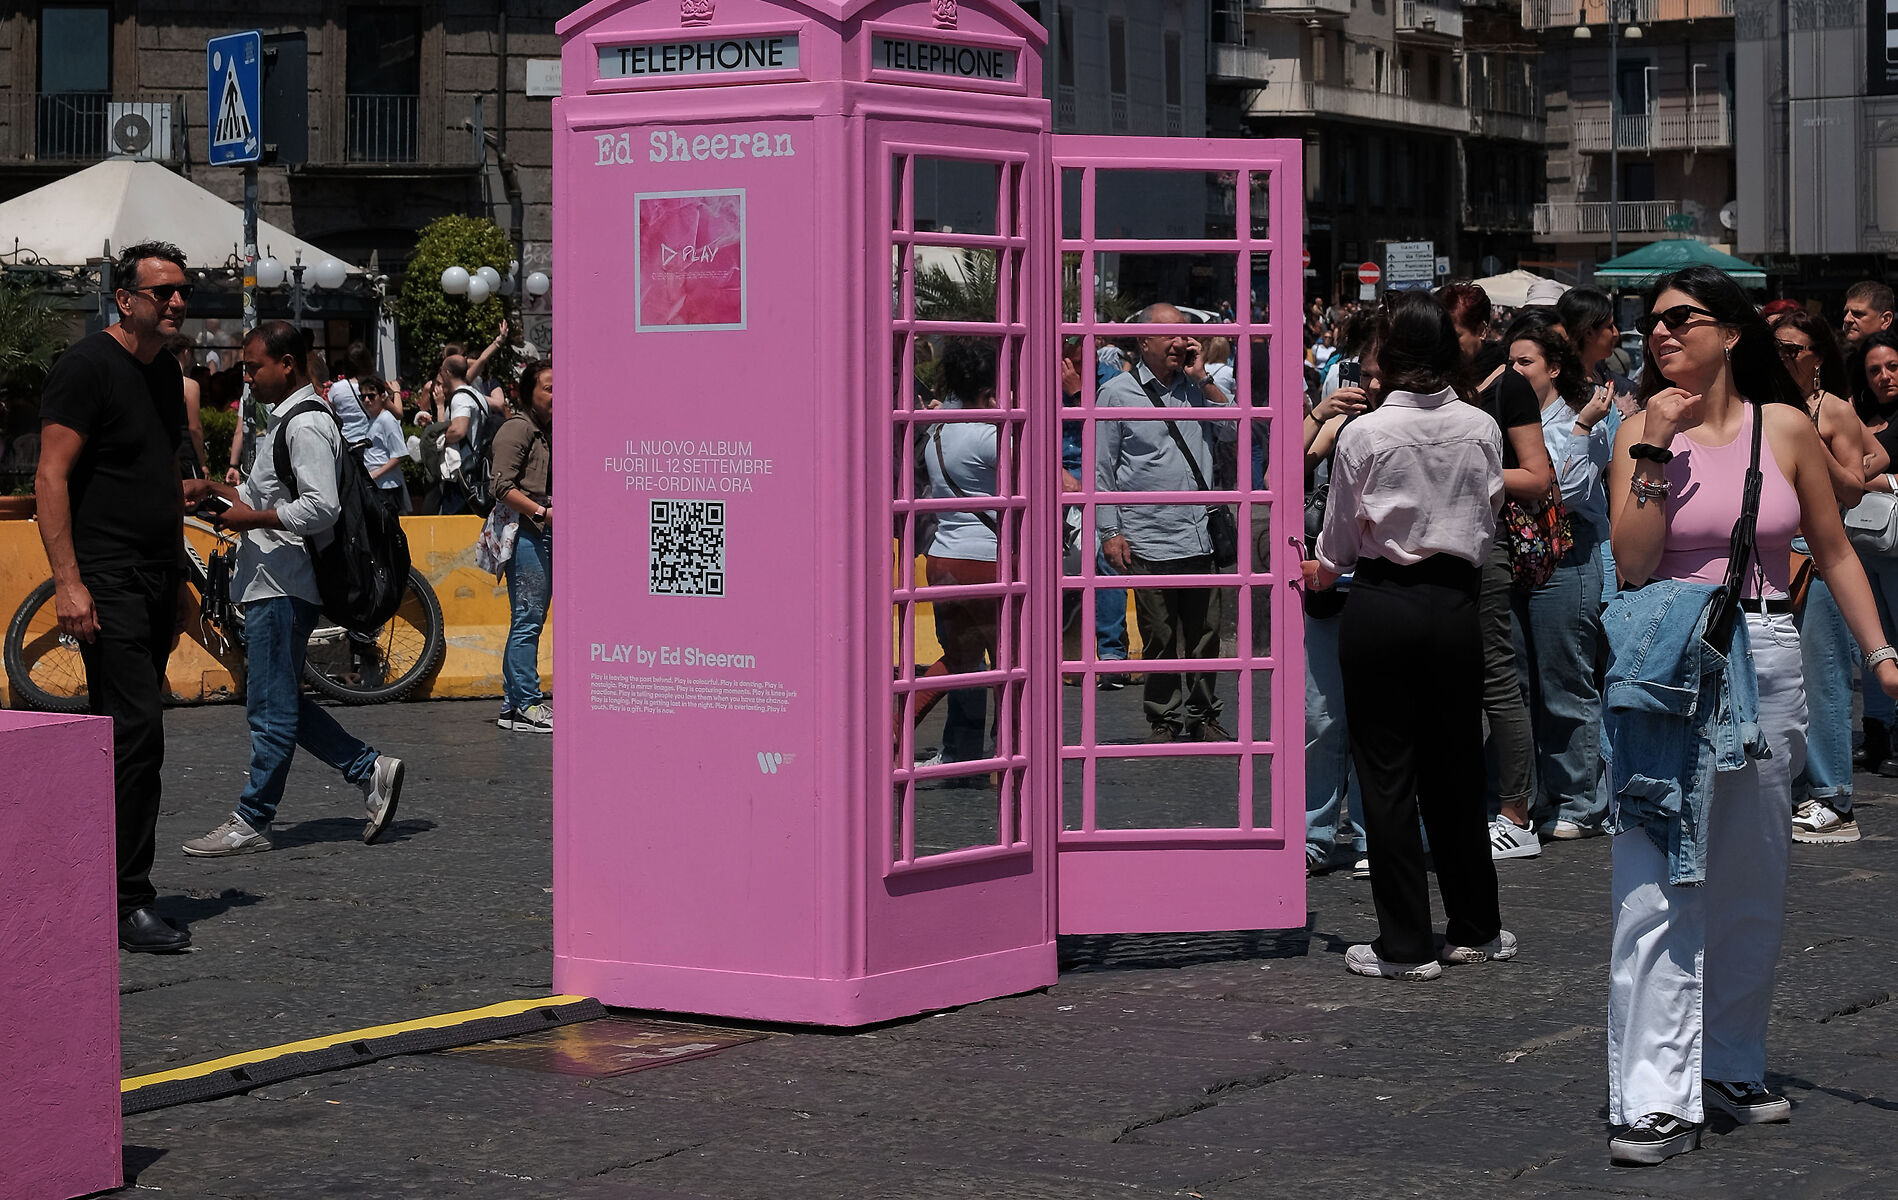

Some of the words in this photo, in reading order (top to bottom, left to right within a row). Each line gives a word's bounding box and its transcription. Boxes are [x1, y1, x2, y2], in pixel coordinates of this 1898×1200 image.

[617, 39, 783, 75] TELEPHONE
[883, 40, 1003, 78] TELEPHONE
[594, 134, 634, 166] Ed
[649, 128, 795, 163] Sheeran
[682, 245, 719, 263] PLAY
[626, 440, 638, 455] IL
[640, 440, 695, 455] NUOVO
[698, 441, 752, 456] ALBUM
[605, 457, 648, 472] FUORI
[651, 458, 663, 472] IL
[666, 458, 680, 473] 12
[683, 458, 773, 474] SETTEMBRE
[625, 475, 717, 491] PRE-ORDINA
[720, 477, 753, 492] ORA
[591, 643, 633, 662] PLAY
[637, 645, 656, 667] by
[661, 646, 681, 665] Ed
[684, 647, 756, 668] Sheeran
